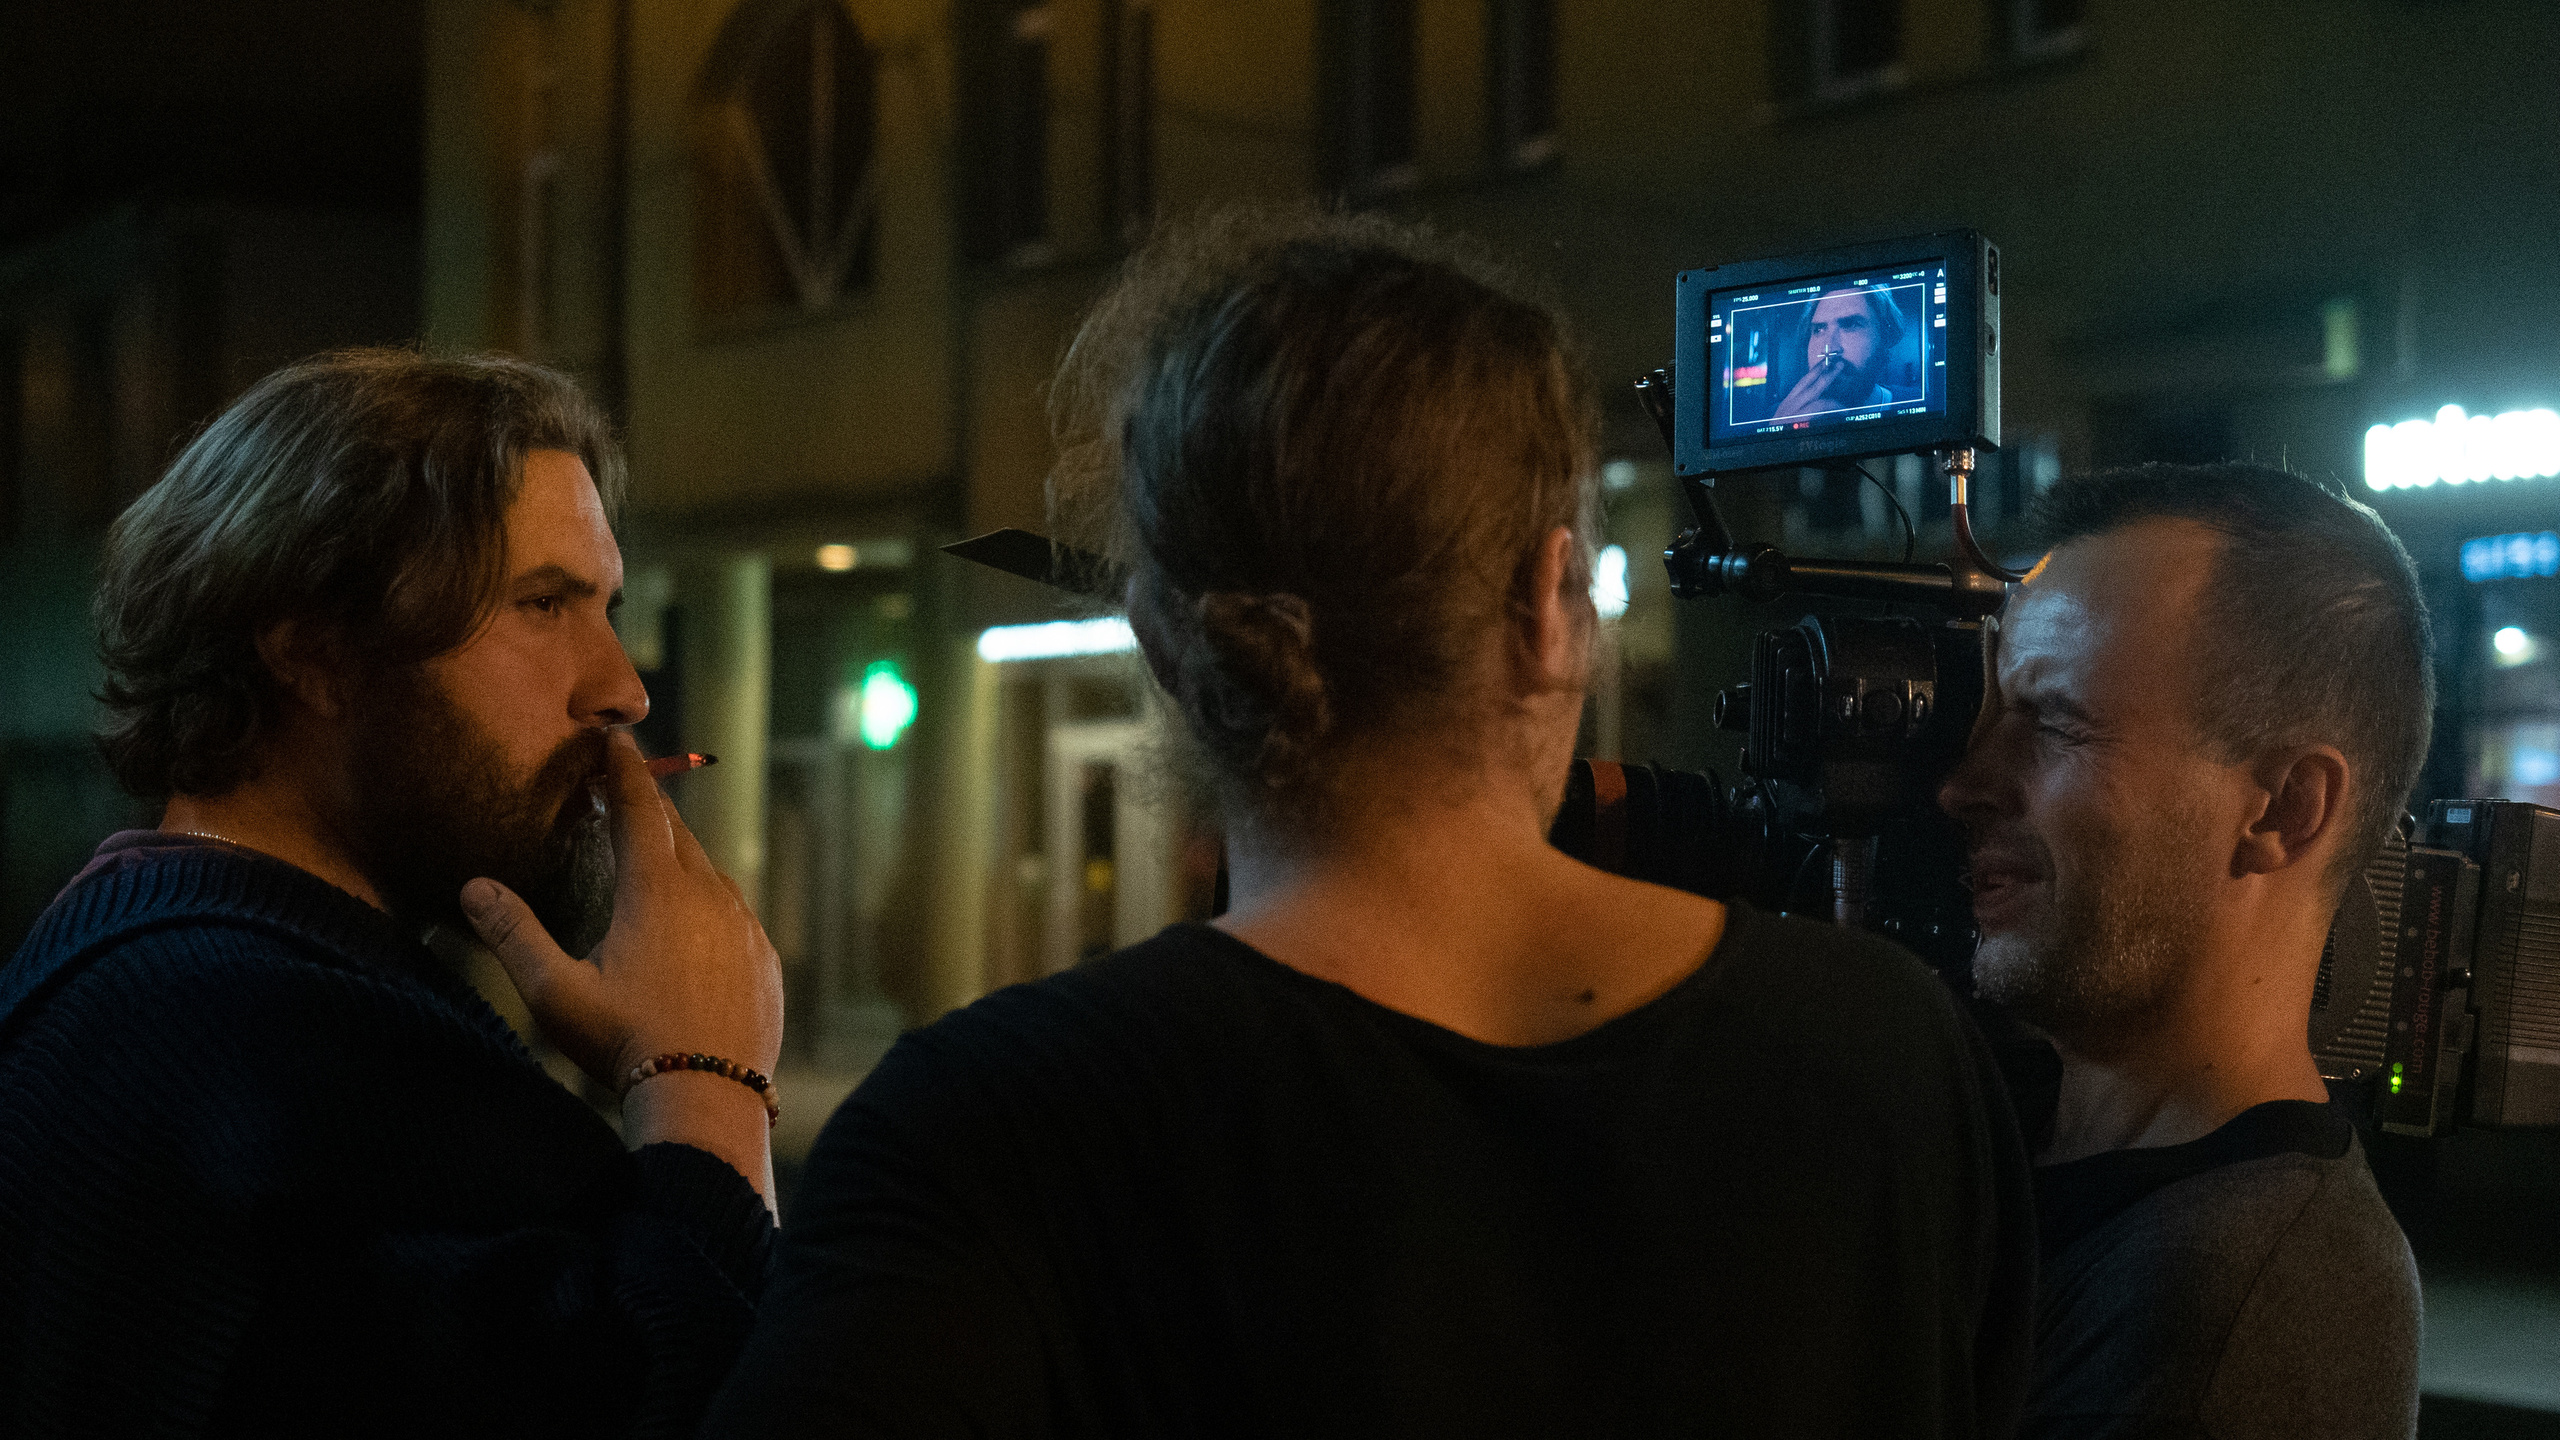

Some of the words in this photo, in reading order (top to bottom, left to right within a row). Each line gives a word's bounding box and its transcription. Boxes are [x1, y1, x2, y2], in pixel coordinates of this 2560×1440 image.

[1937, 268, 1944, 278] A
[1858, 278, 1868, 286] 800
[1741, 294, 1759, 303] 25.000
[1768, 425, 1784, 433] 15.5V
[1799, 421, 1810, 429] REC
[1895, 921, 1900, 930] 1
[1933, 925, 1939, 934] 2
[1971, 930, 1976, 938] 3
[2411, 885, 2442, 1074] www.bebob-rouge.com
